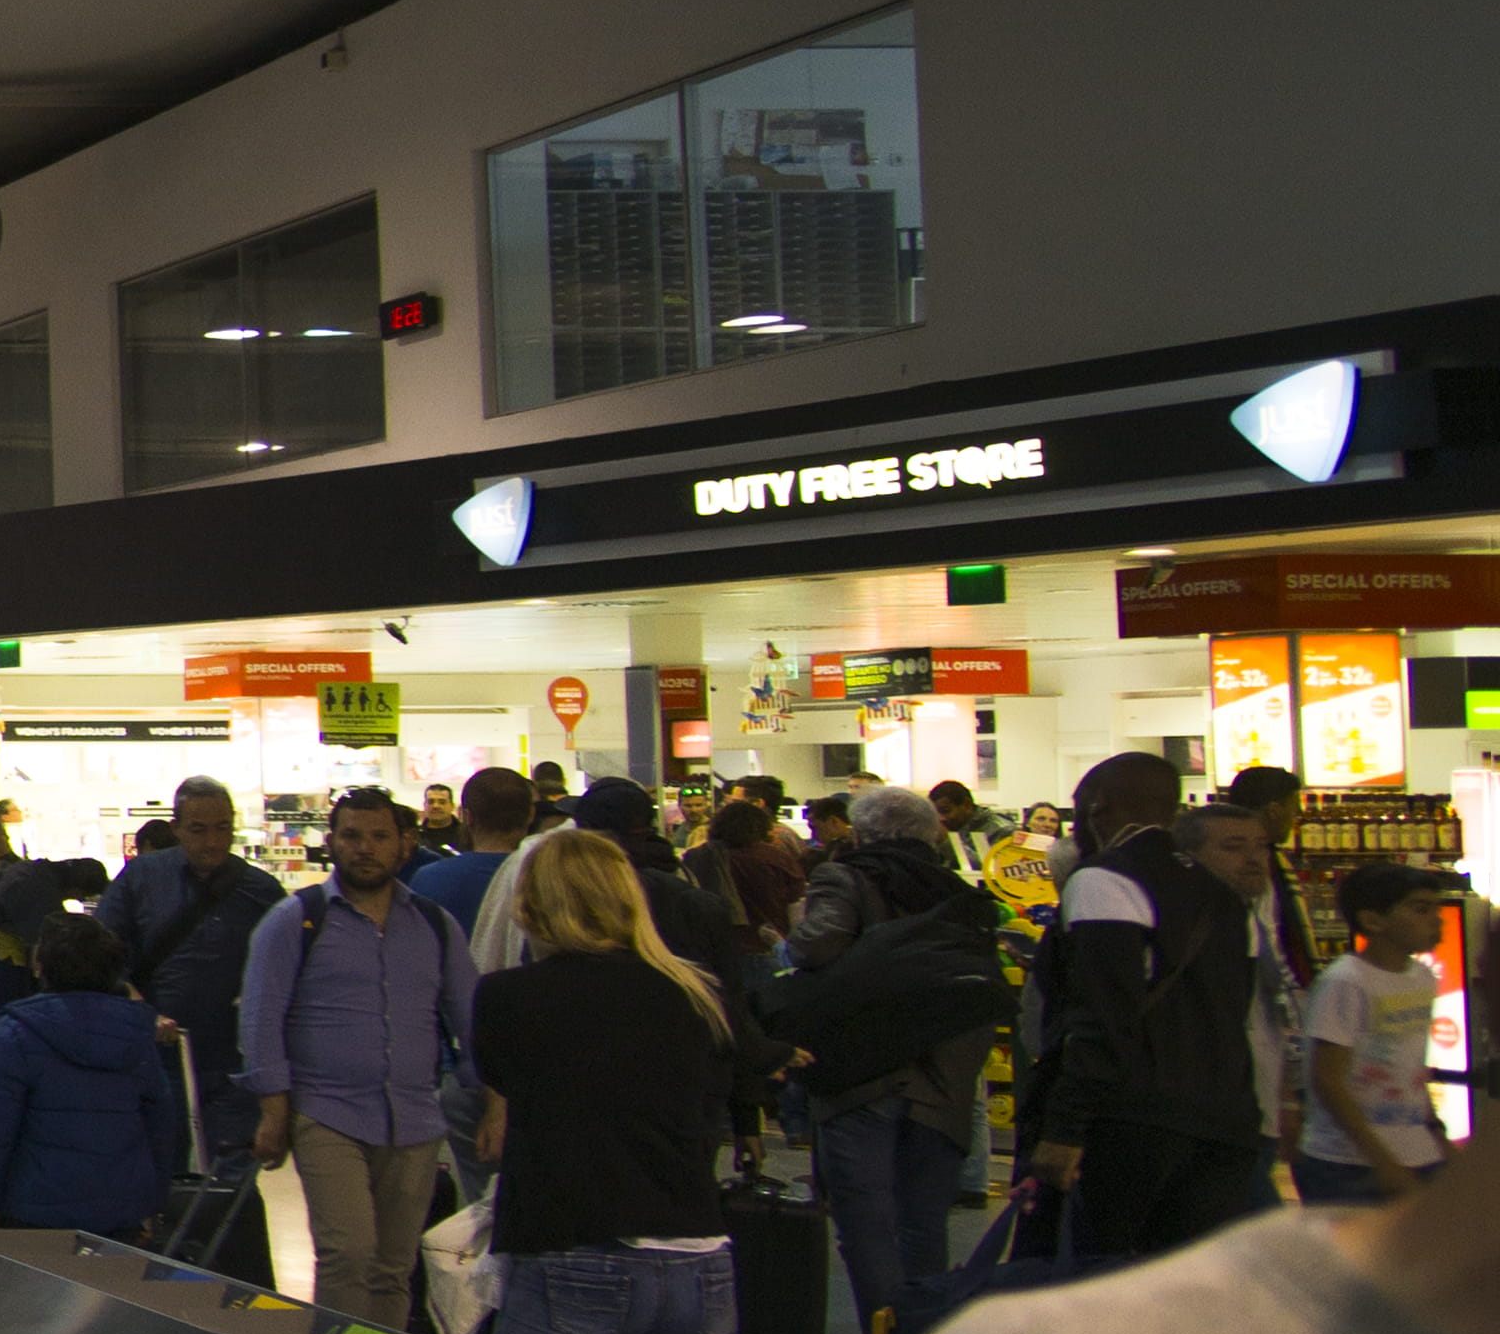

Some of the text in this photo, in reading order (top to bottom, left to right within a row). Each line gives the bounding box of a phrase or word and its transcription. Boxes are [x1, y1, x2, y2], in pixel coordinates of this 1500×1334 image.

[694, 437, 1045, 516] DUTY FREE STORE
[1121, 579, 1242, 602] SPECIAL OFFER%
[1285, 573, 1451, 590] SPECIAL OFFER%
[244, 662, 347, 674] SPECIAL OFFER%
[952, 660, 1003, 671] OFFER%
[1214, 670, 1227, 689] 2
[1303, 665, 1319, 687] 2
